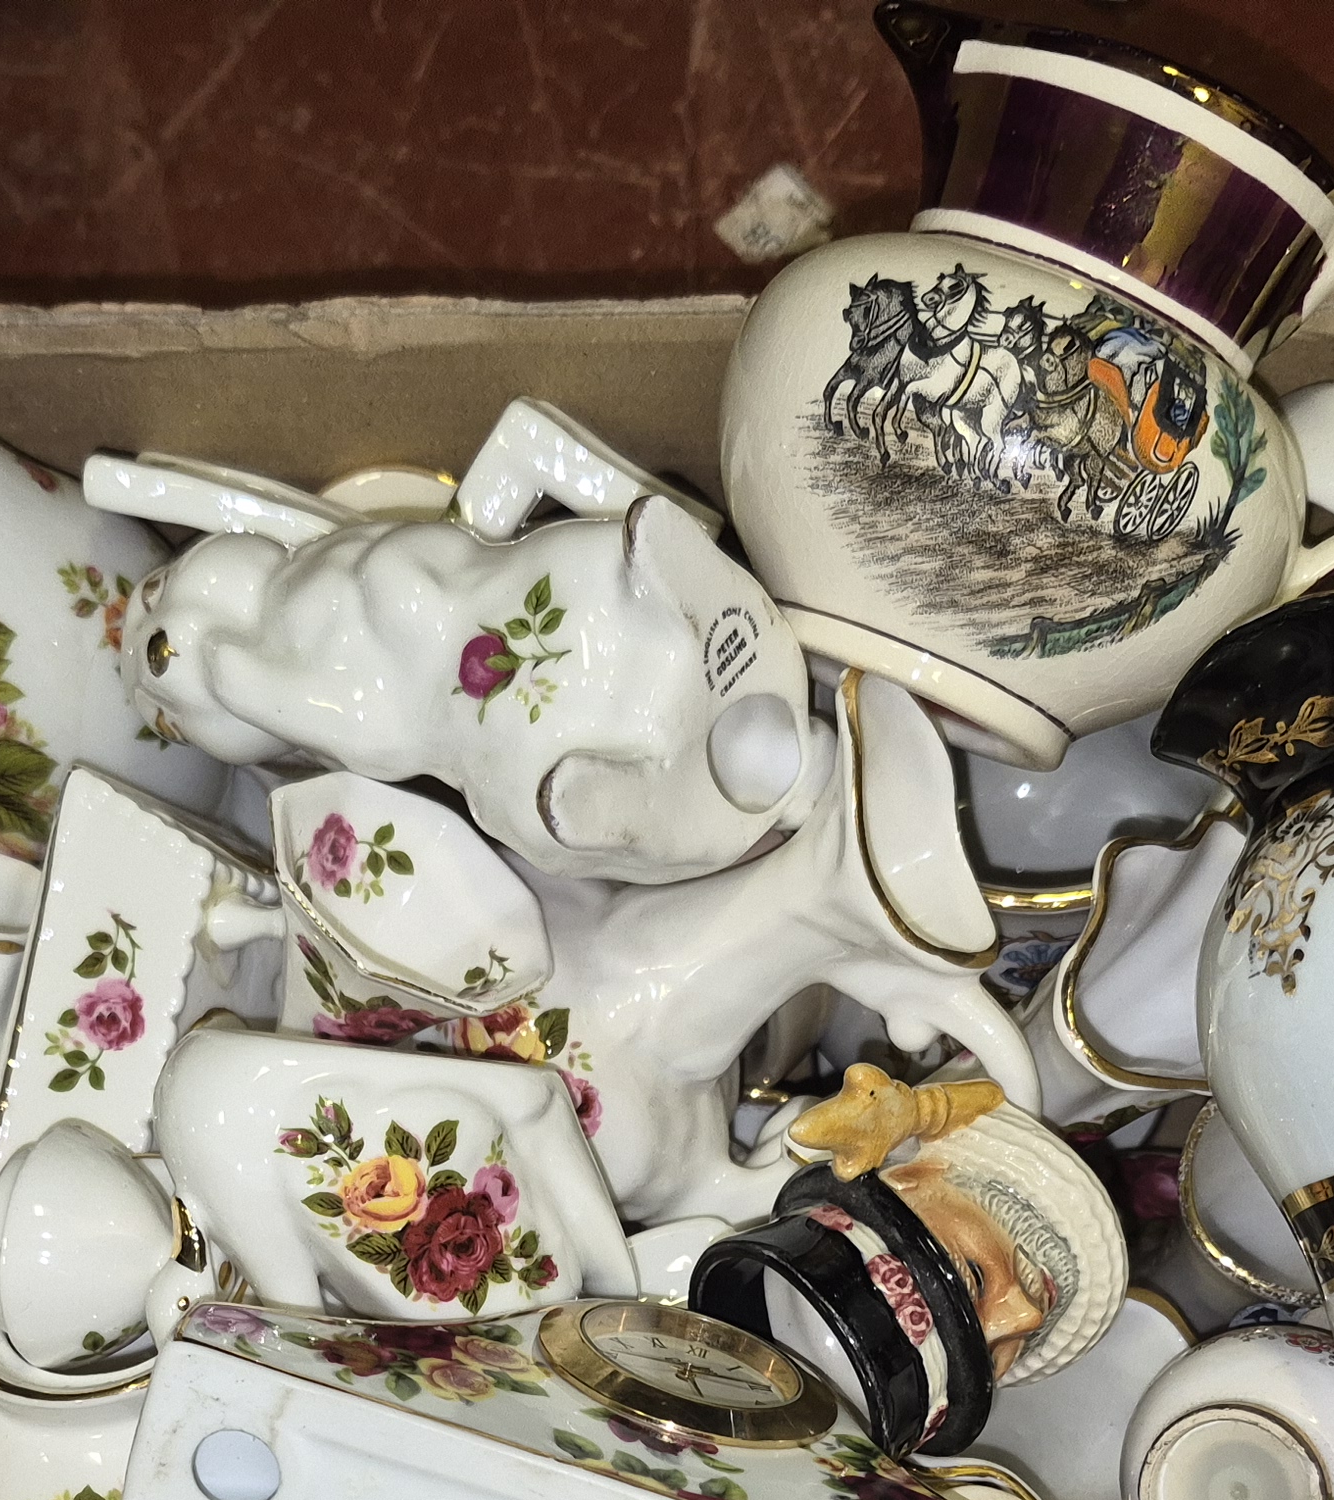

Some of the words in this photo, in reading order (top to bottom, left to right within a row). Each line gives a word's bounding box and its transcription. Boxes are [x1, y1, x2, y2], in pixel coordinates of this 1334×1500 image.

[704, 619, 719, 664] ENGLISH
[744, 611, 759, 639] CHINA
[717, 628, 739, 659] PETER
[717, 637, 747, 676] GOSLING
[720, 652, 757, 697] CRAFTWARE
[686, 1344, 711, 1359] XII
